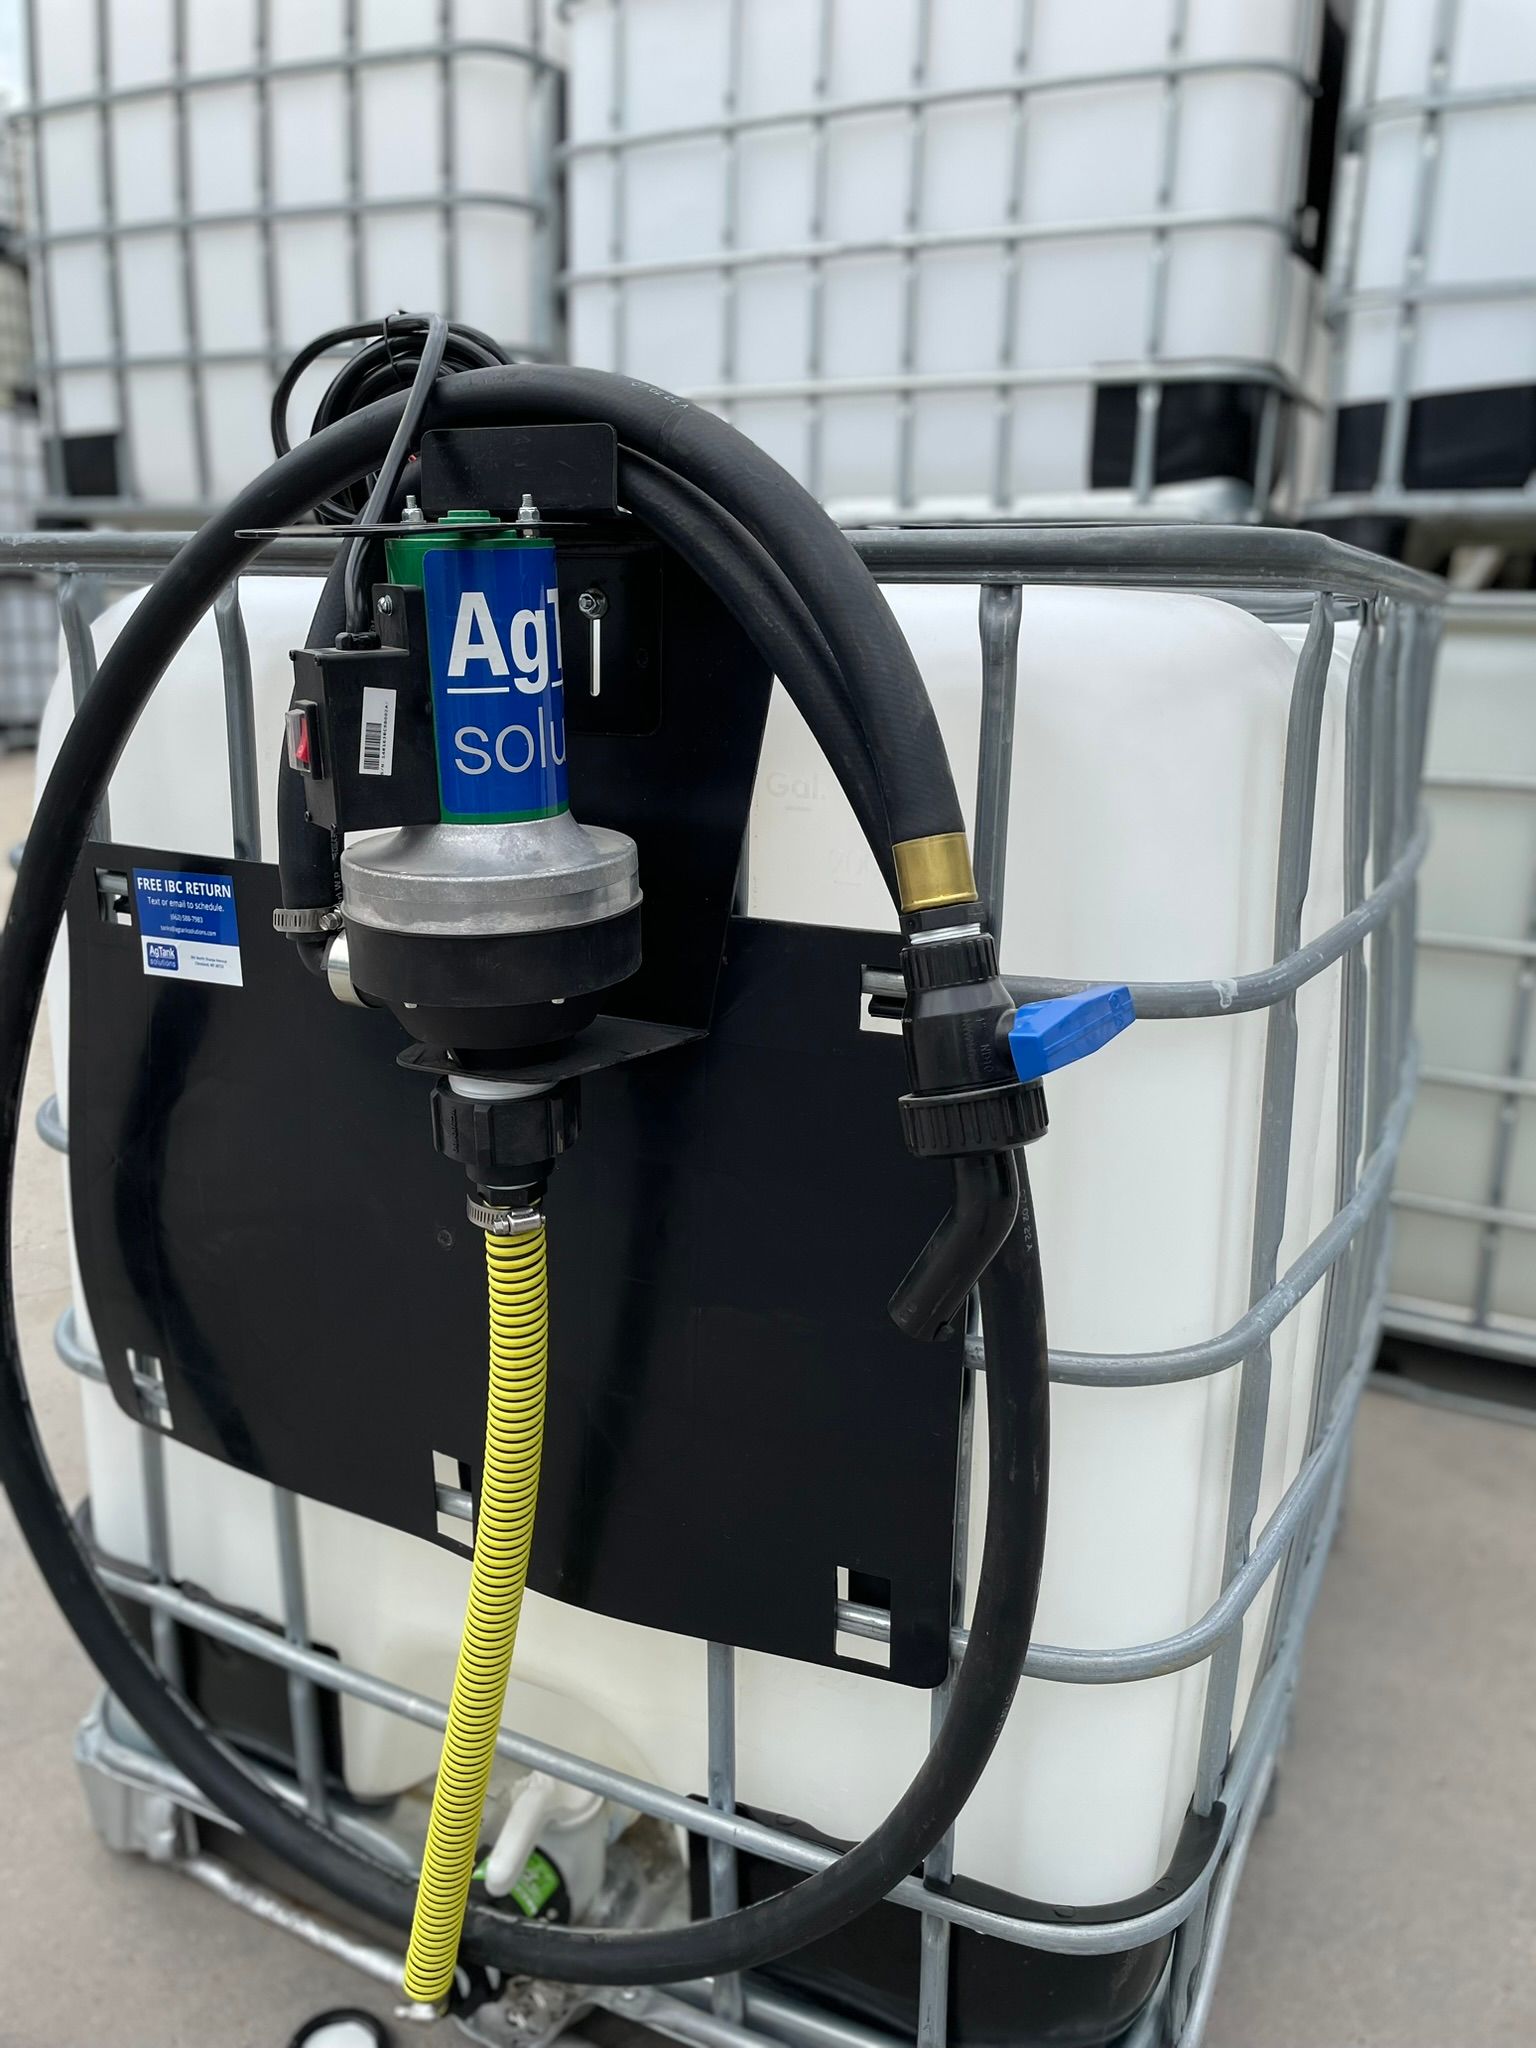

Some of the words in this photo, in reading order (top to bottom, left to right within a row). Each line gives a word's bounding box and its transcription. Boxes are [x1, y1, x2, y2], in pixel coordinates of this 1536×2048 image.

[137, 877, 163, 892] FREE
[164, 879, 183, 894] IBC
[185, 881, 232, 899] RETURN
[147, 896, 161, 906] Text
[162, 899, 169, 907] or
[169, 898, 187, 908] email
[187, 901, 194, 910] to
[195, 901, 225, 913] schedule.
[149, 945, 176, 960] AgTank
[150, 958, 177, 969] solutions
[1023, 1225, 1032, 1242] 22
